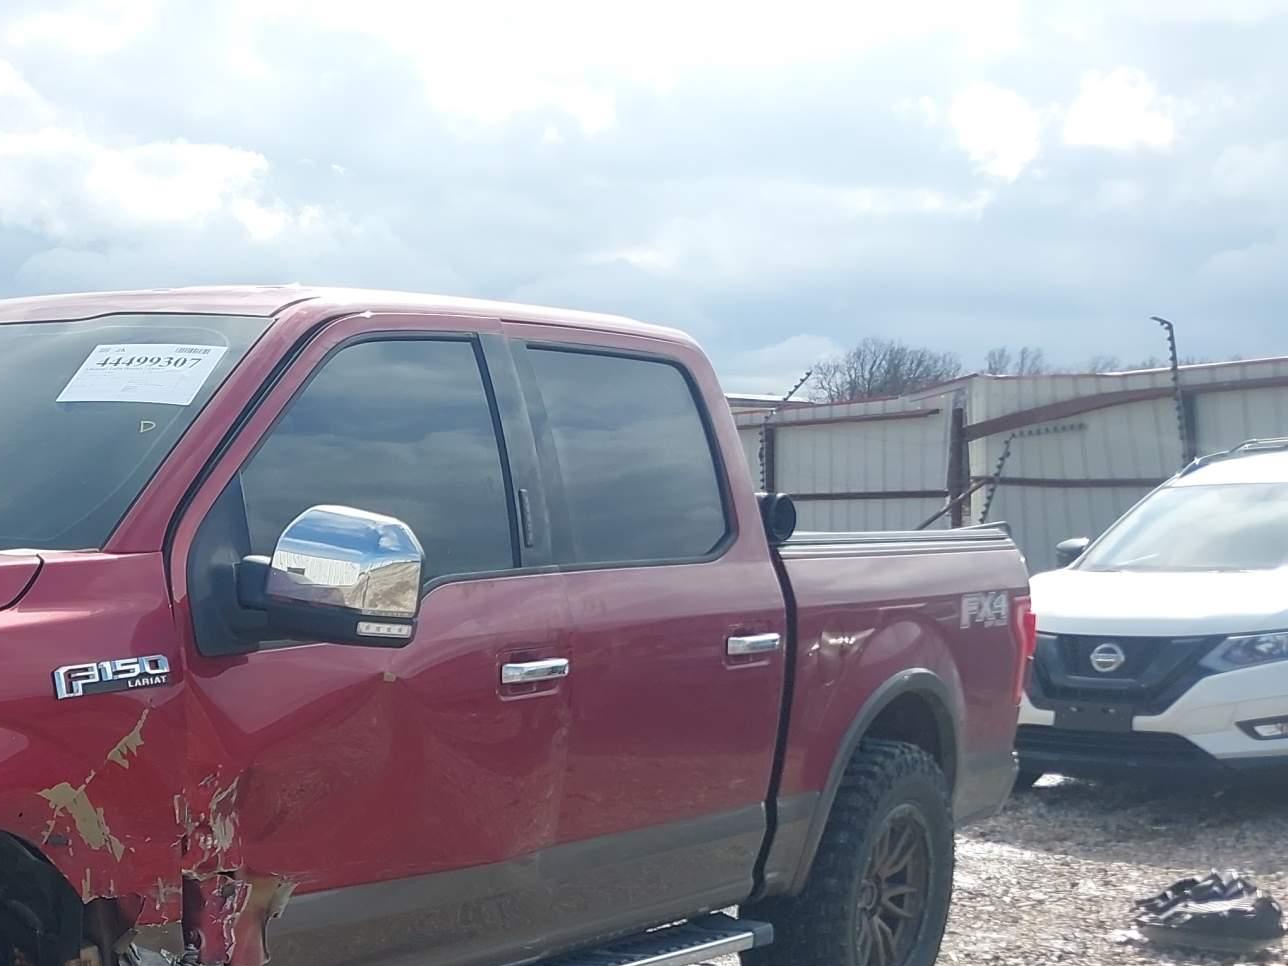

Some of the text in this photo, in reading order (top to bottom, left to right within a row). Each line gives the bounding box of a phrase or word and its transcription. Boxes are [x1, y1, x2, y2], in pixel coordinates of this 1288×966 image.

[95, 355, 202, 369] 44499307
[959, 591, 1008, 630] FX4
[127, 674, 168, 688] LARIAT
